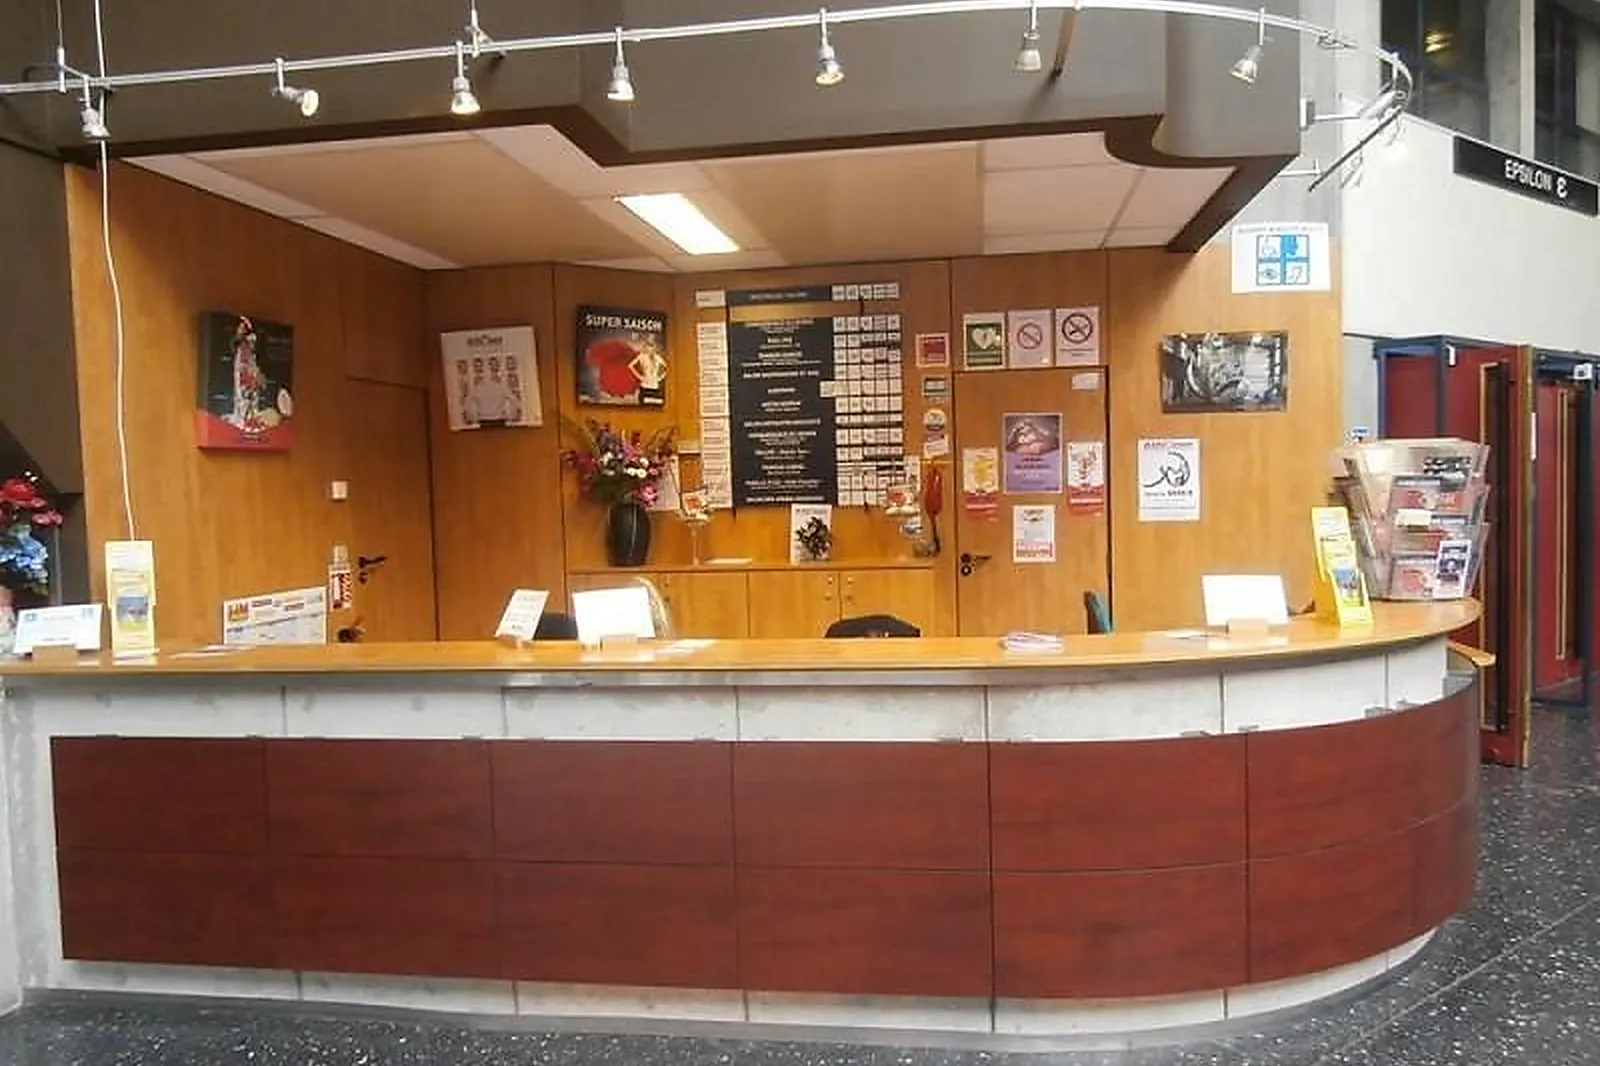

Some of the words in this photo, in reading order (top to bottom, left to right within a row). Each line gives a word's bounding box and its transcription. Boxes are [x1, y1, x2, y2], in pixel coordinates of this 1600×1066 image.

[1504, 160, 1552, 190] EPSILON
[585, 313, 621, 328] SUPER
[623, 318, 662, 332] SAISON
